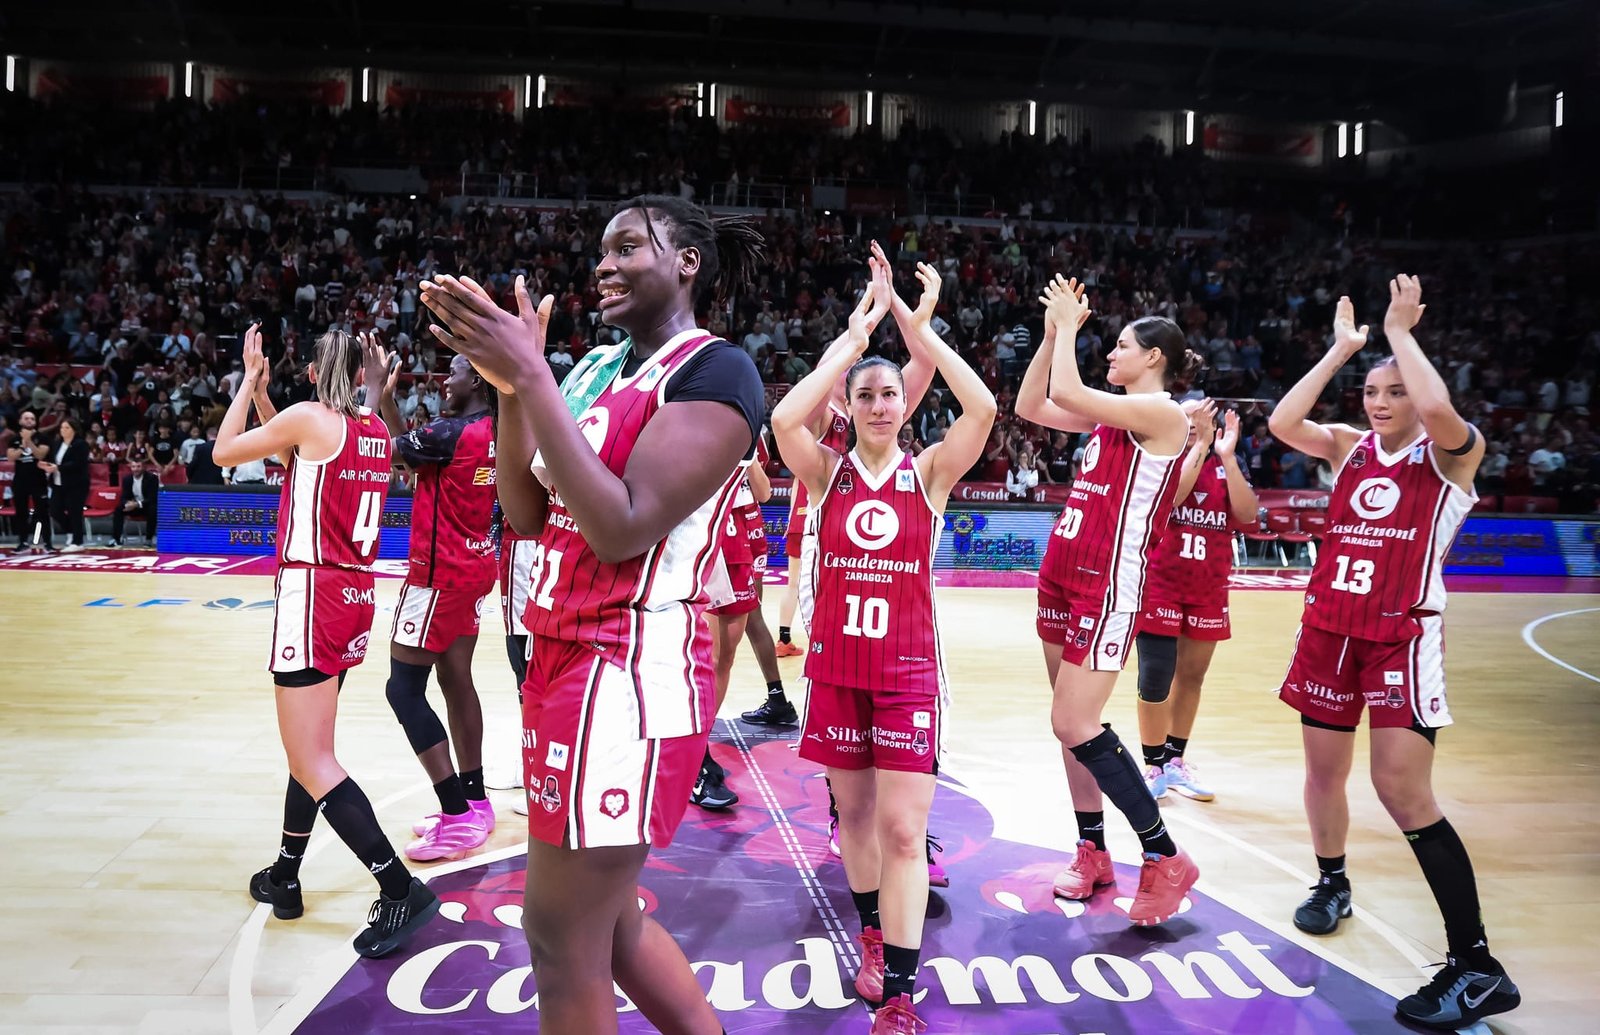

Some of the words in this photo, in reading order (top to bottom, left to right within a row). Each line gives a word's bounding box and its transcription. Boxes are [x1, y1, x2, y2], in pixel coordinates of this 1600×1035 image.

[358, 435, 387, 459] ORTIZ
[338, 468, 356, 481] AIR
[351, 491, 382, 557] 4
[1054, 505, 1084, 540] 20
[1170, 505, 1227, 527] AMBAR
[1179, 532, 1207, 561] 16
[823, 551, 921, 575] Casademont
[1330, 555, 1377, 595] 13
[527, 543, 564, 612] 31
[844, 571, 893, 584] ZARAGOZA
[842, 593, 890, 640] 10
[1303, 679, 1355, 703] Silken
[877, 728, 912, 741] Zaragoza
[384, 930, 1316, 1015] Caadmont
